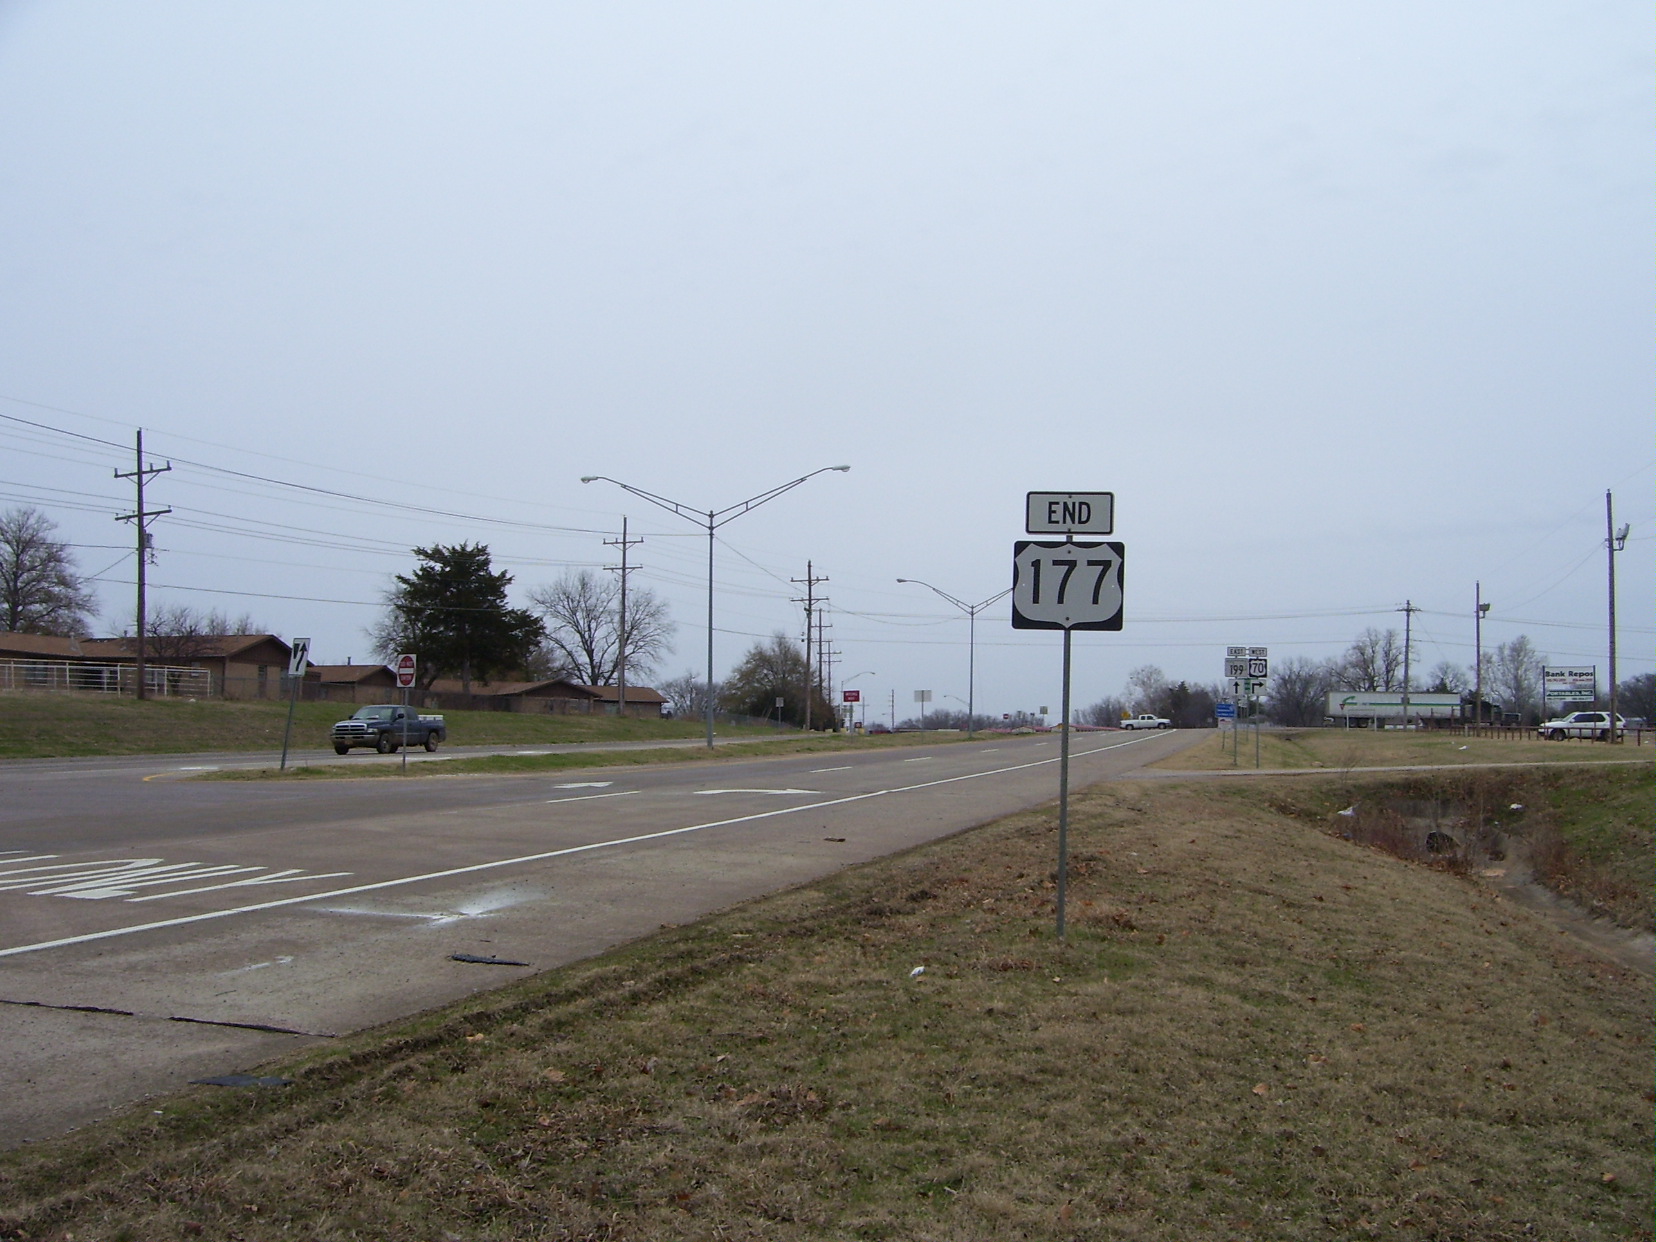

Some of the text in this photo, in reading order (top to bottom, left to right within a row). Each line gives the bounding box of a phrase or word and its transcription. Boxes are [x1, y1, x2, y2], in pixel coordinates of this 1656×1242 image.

[1047, 501, 1092, 525] END
[1030, 558, 1112, 605] 177
[1230, 664, 1244, 675] 199
[1251, 662, 1264, 674] 70
[1545, 670, 1594, 679] Bank Repos
